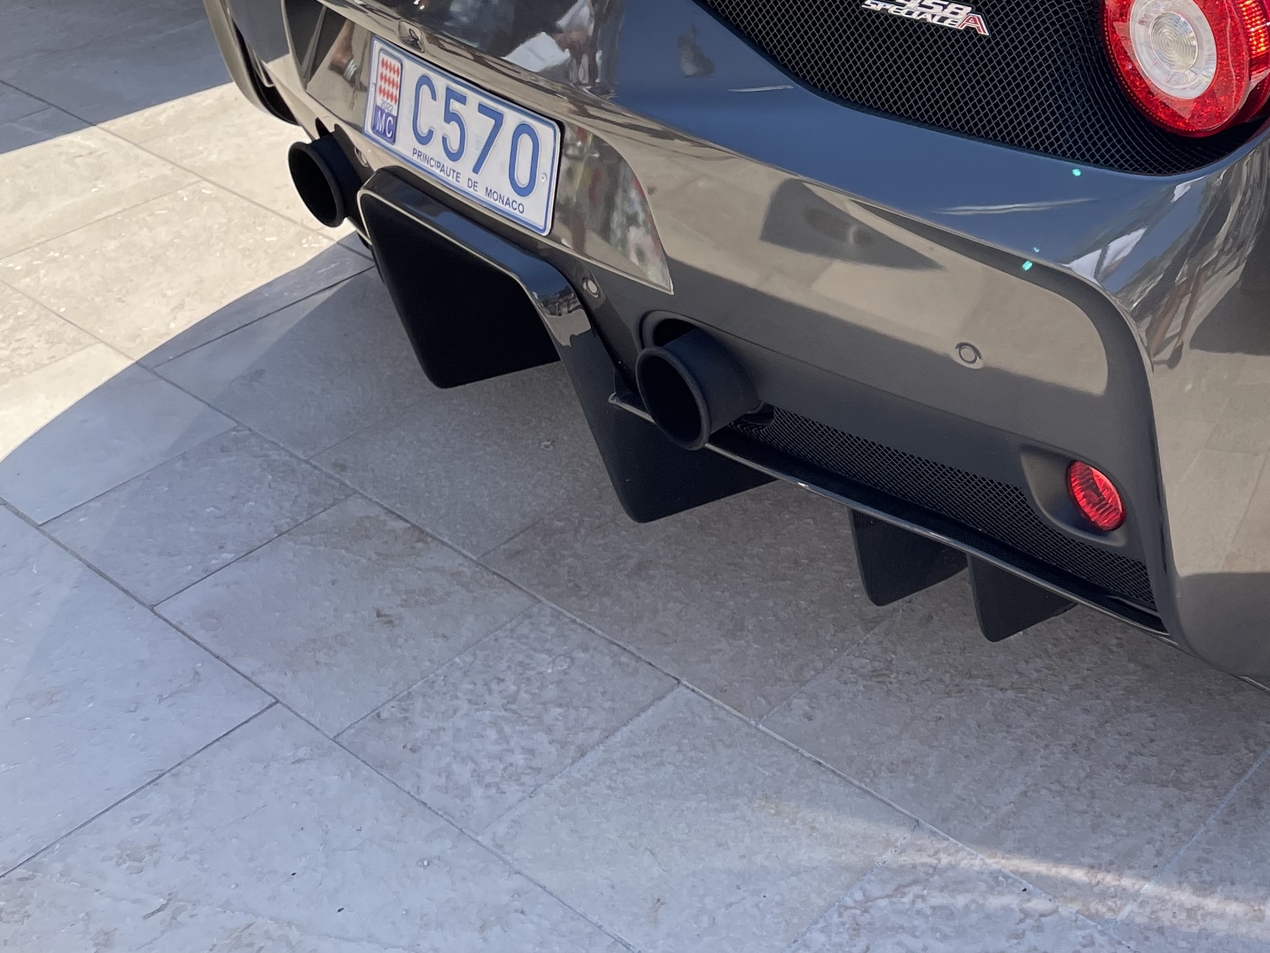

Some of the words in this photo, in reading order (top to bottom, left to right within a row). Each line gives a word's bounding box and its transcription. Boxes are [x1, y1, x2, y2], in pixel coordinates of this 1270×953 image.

[862, 0, 962, 29] SPECIALE
[957, 13, 989, 36] A
[381, 98, 394, 113] 2022
[376, 110, 394, 138] MC
[412, 74, 540, 198] C570
[412, 147, 461, 184] PRINCIPAUTE
[467, 177, 479, 193] DE
[485, 185, 525, 214] MONACO
